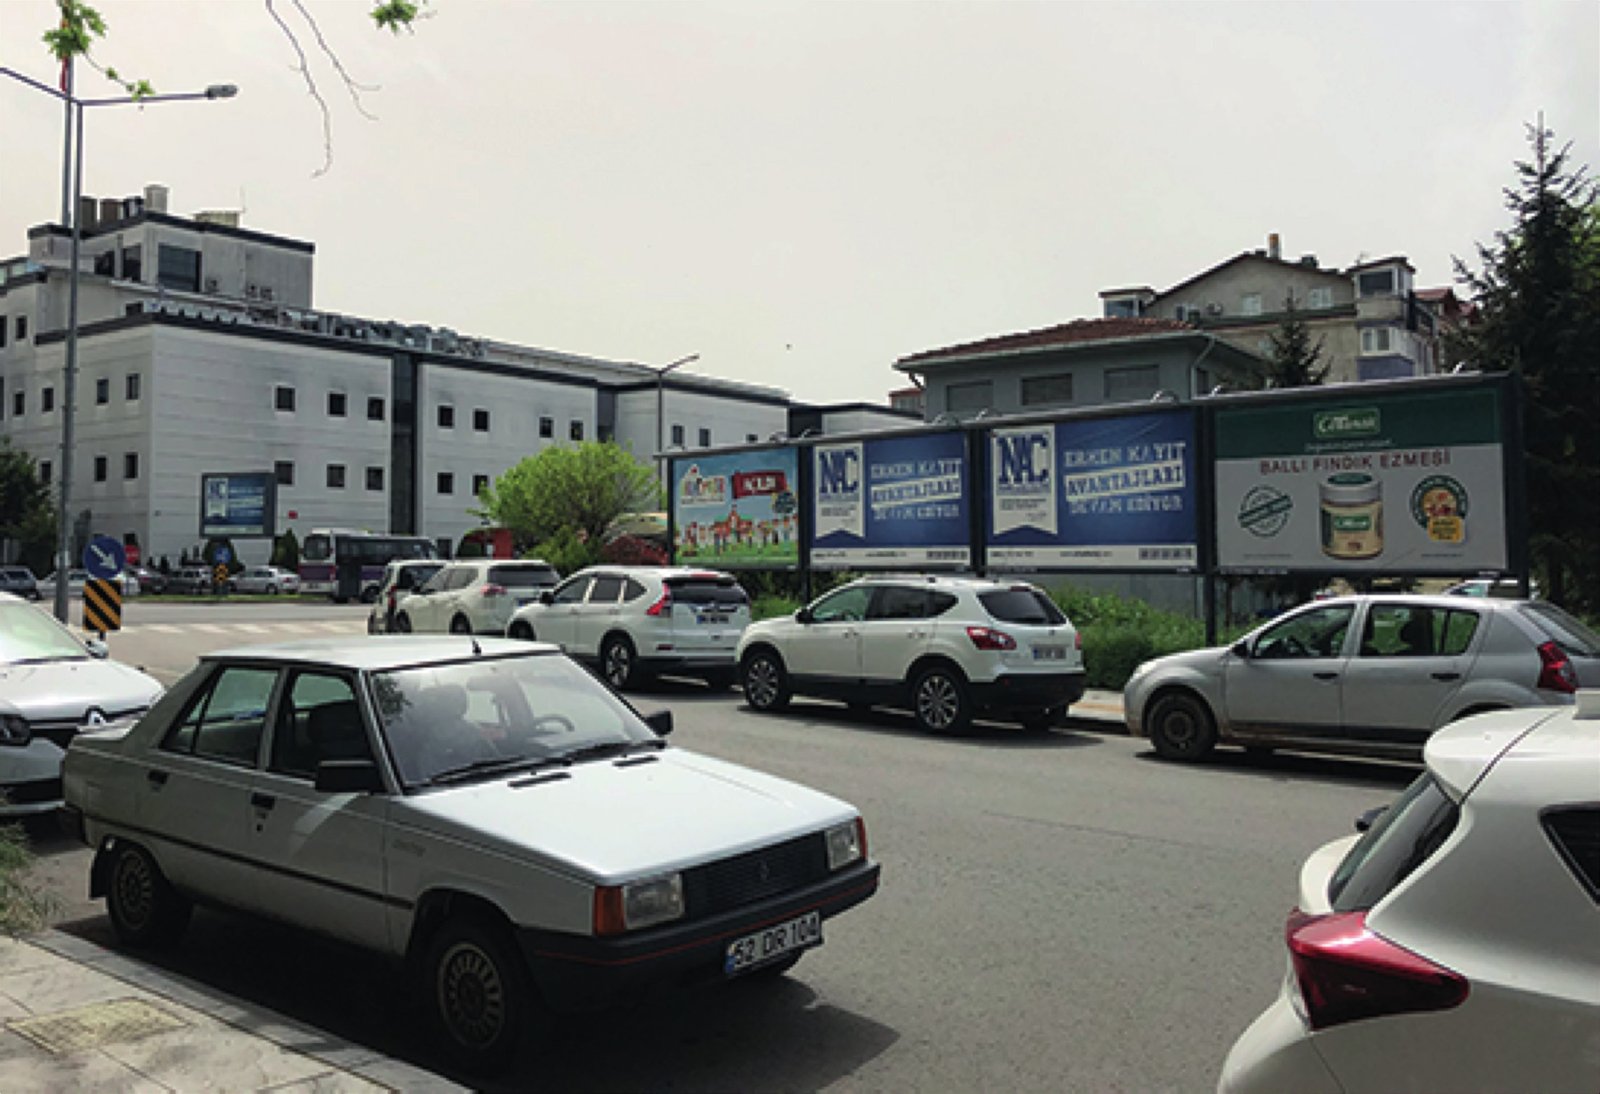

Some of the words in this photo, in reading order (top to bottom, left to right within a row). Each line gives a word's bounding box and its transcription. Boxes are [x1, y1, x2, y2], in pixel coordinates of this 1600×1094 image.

[1260, 459, 1306, 475] BALLI
[1313, 454, 1373, 471] FINDIK
[1380, 448, 1451, 468] EZMESİ
[1068, 465, 1182, 497] AVANTAJLARI
